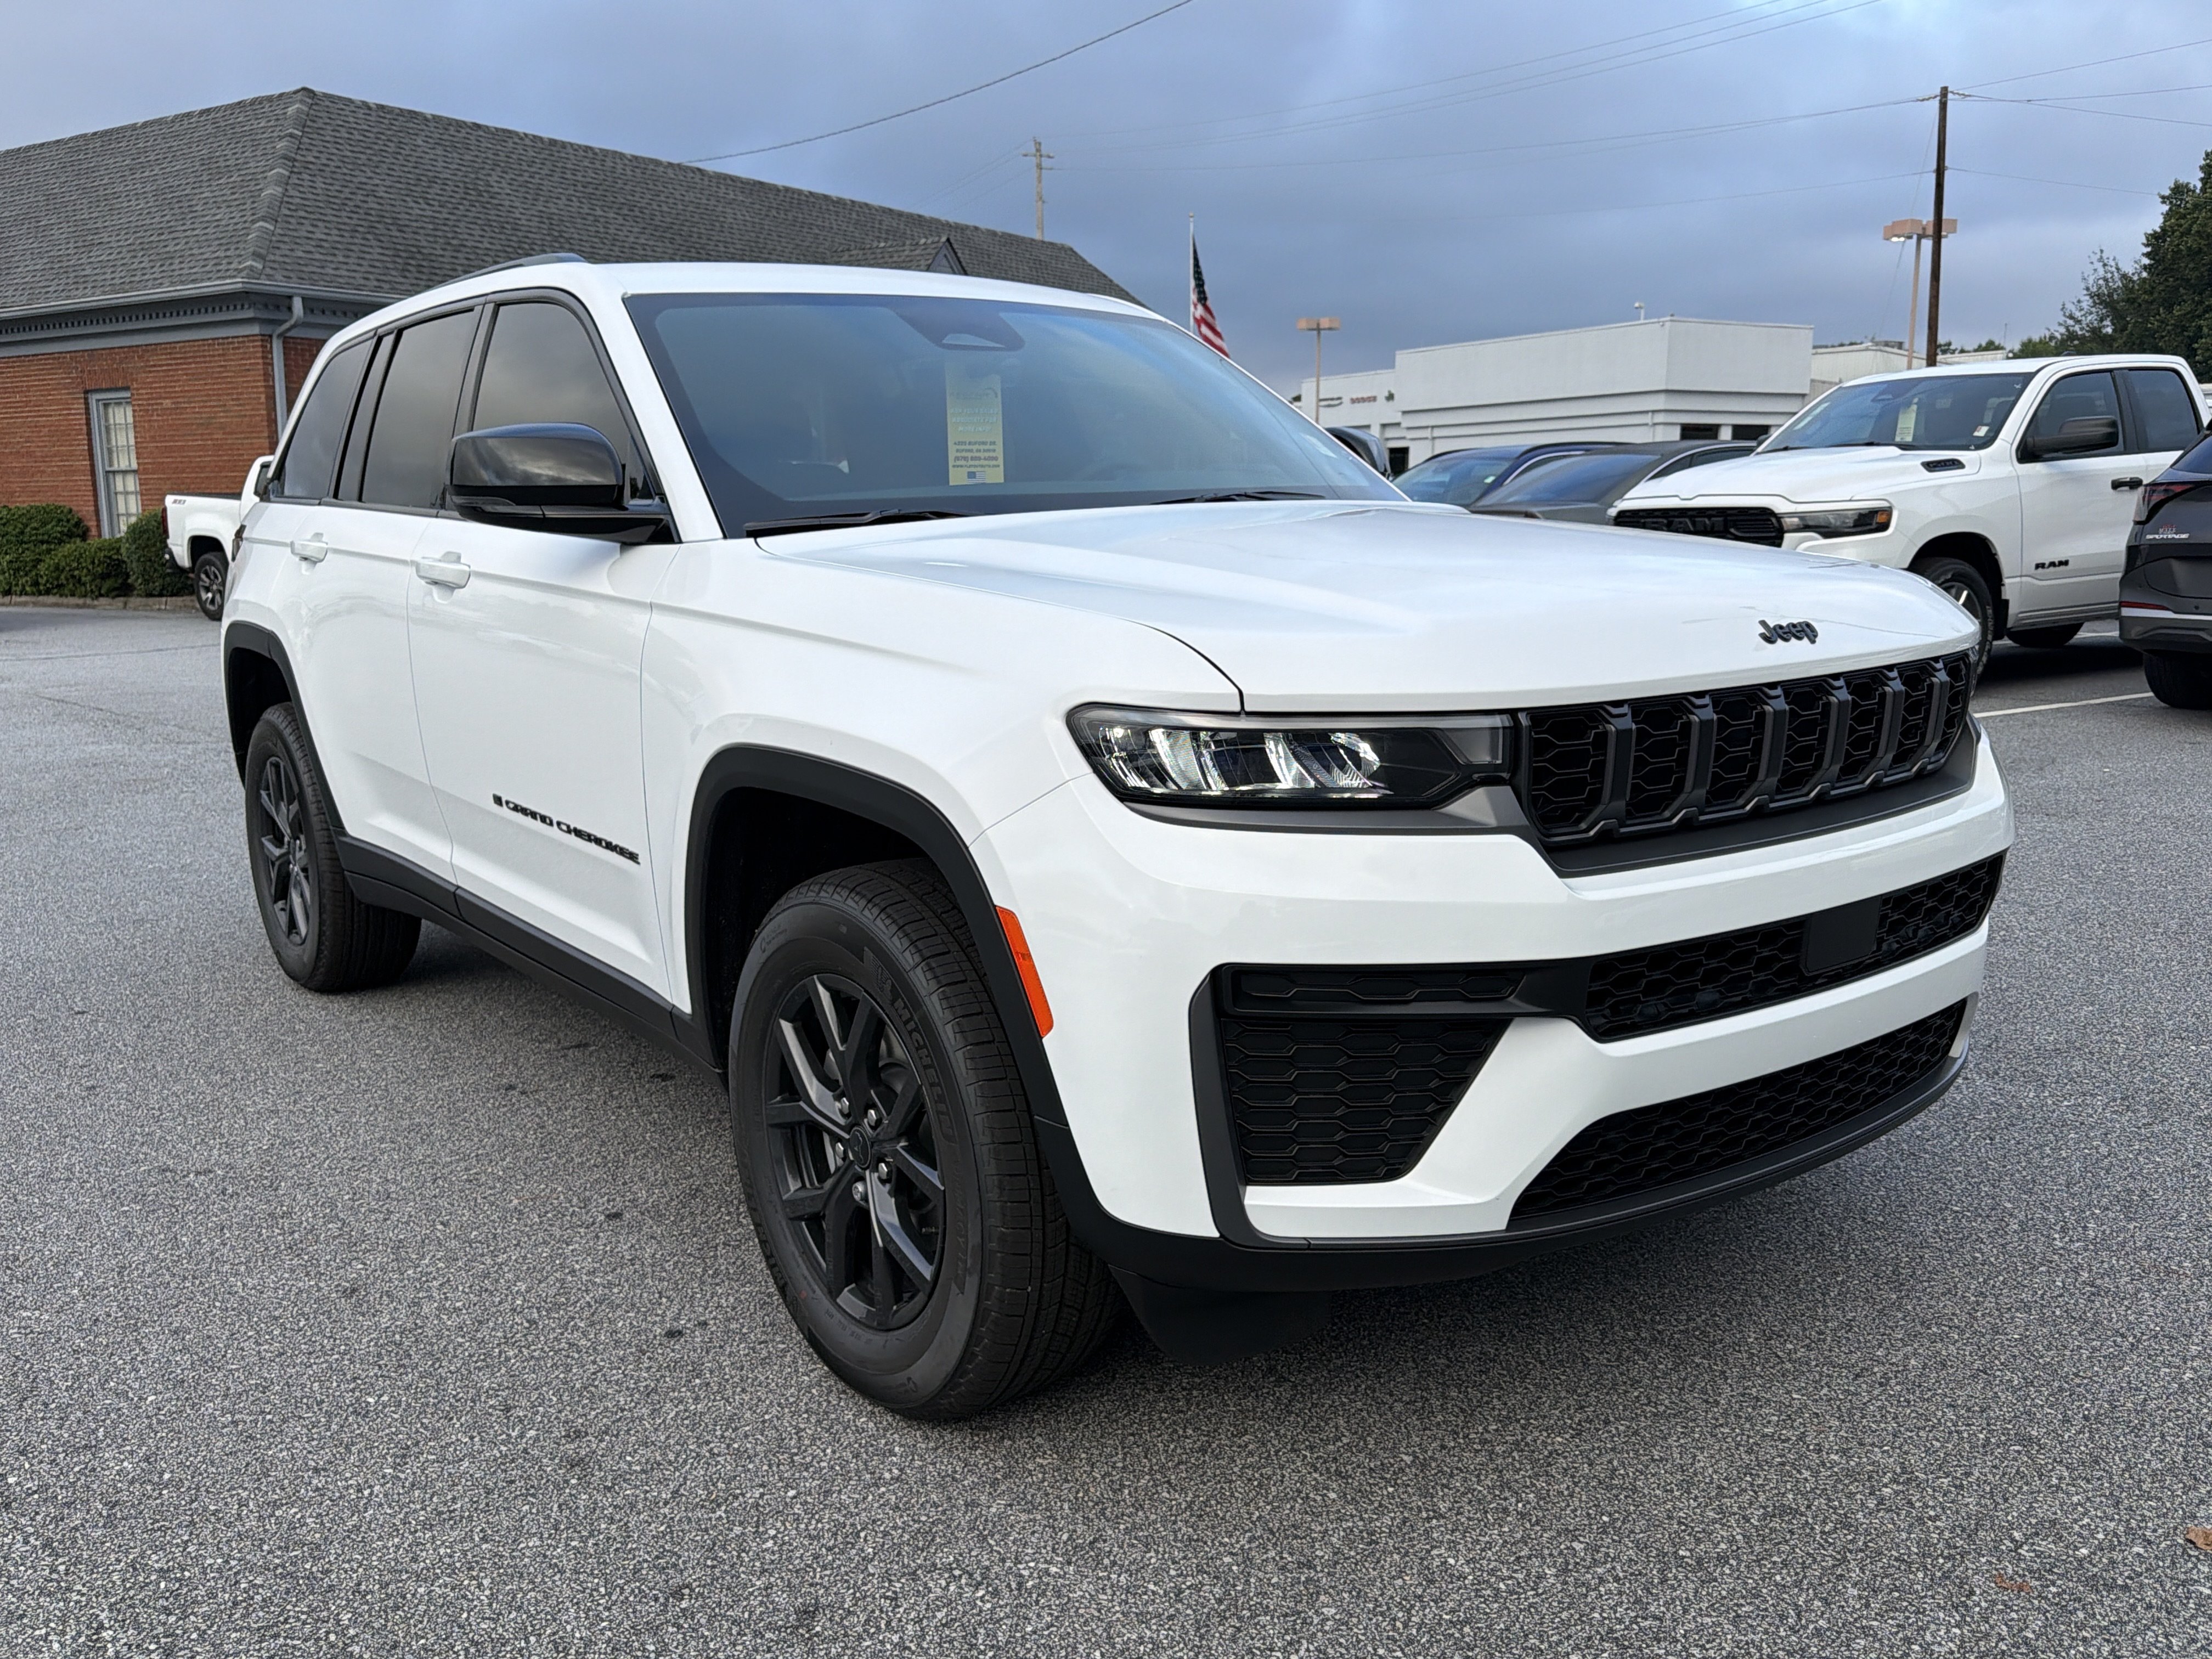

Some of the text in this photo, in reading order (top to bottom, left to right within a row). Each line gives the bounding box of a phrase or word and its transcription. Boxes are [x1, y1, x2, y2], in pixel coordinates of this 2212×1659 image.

[2034, 558, 2069, 571] RAM
[1758, 619, 1819, 645] Jeep
[504, 799, 641, 866] GRAND CHEROKEE
[893, 997, 954, 1140] MICHELIN
